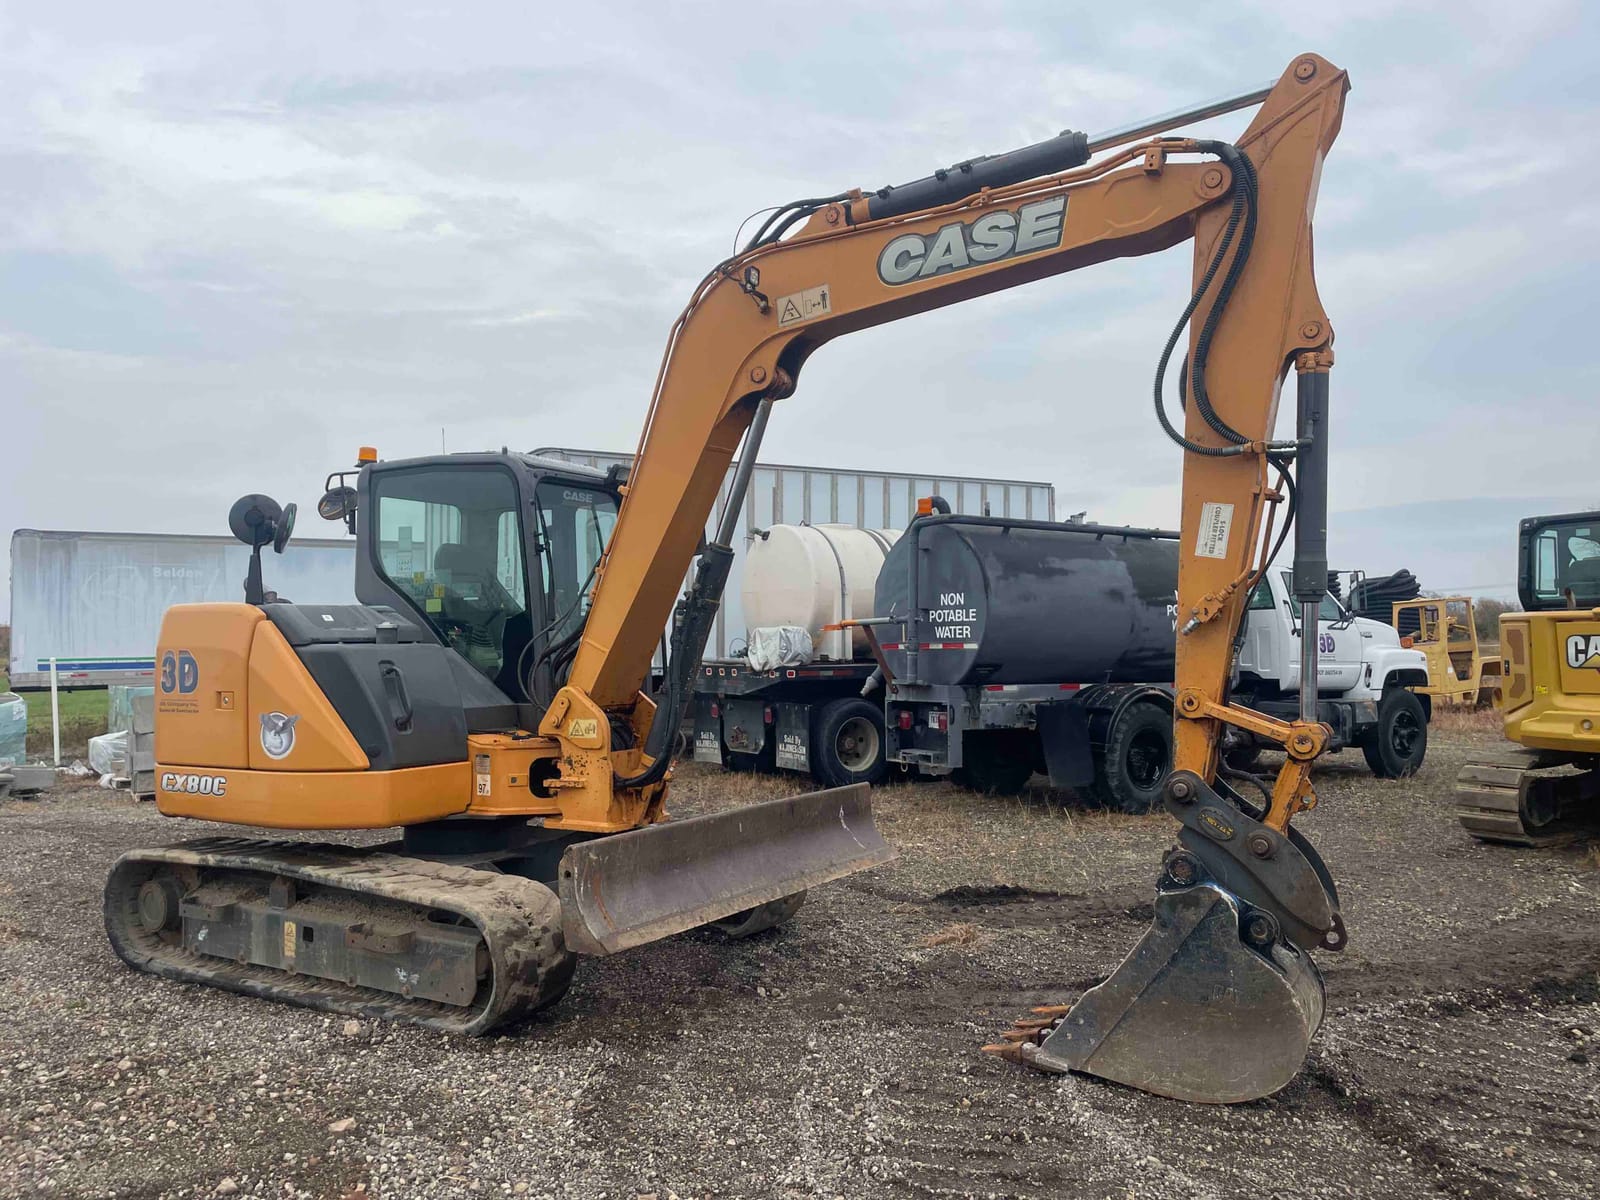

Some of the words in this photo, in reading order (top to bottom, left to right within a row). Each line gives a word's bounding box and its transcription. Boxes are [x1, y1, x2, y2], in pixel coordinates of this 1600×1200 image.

[878, 193, 1067, 285] CASE
[563, 490, 593, 503] CASE
[940, 592, 965, 606] NON
[929, 608, 977, 622] POTABLE
[934, 625, 971, 639] WATER
[160, 649, 199, 694] 3D
[161, 772, 227, 796] CX80C
[478, 783, 487, 794] 97
